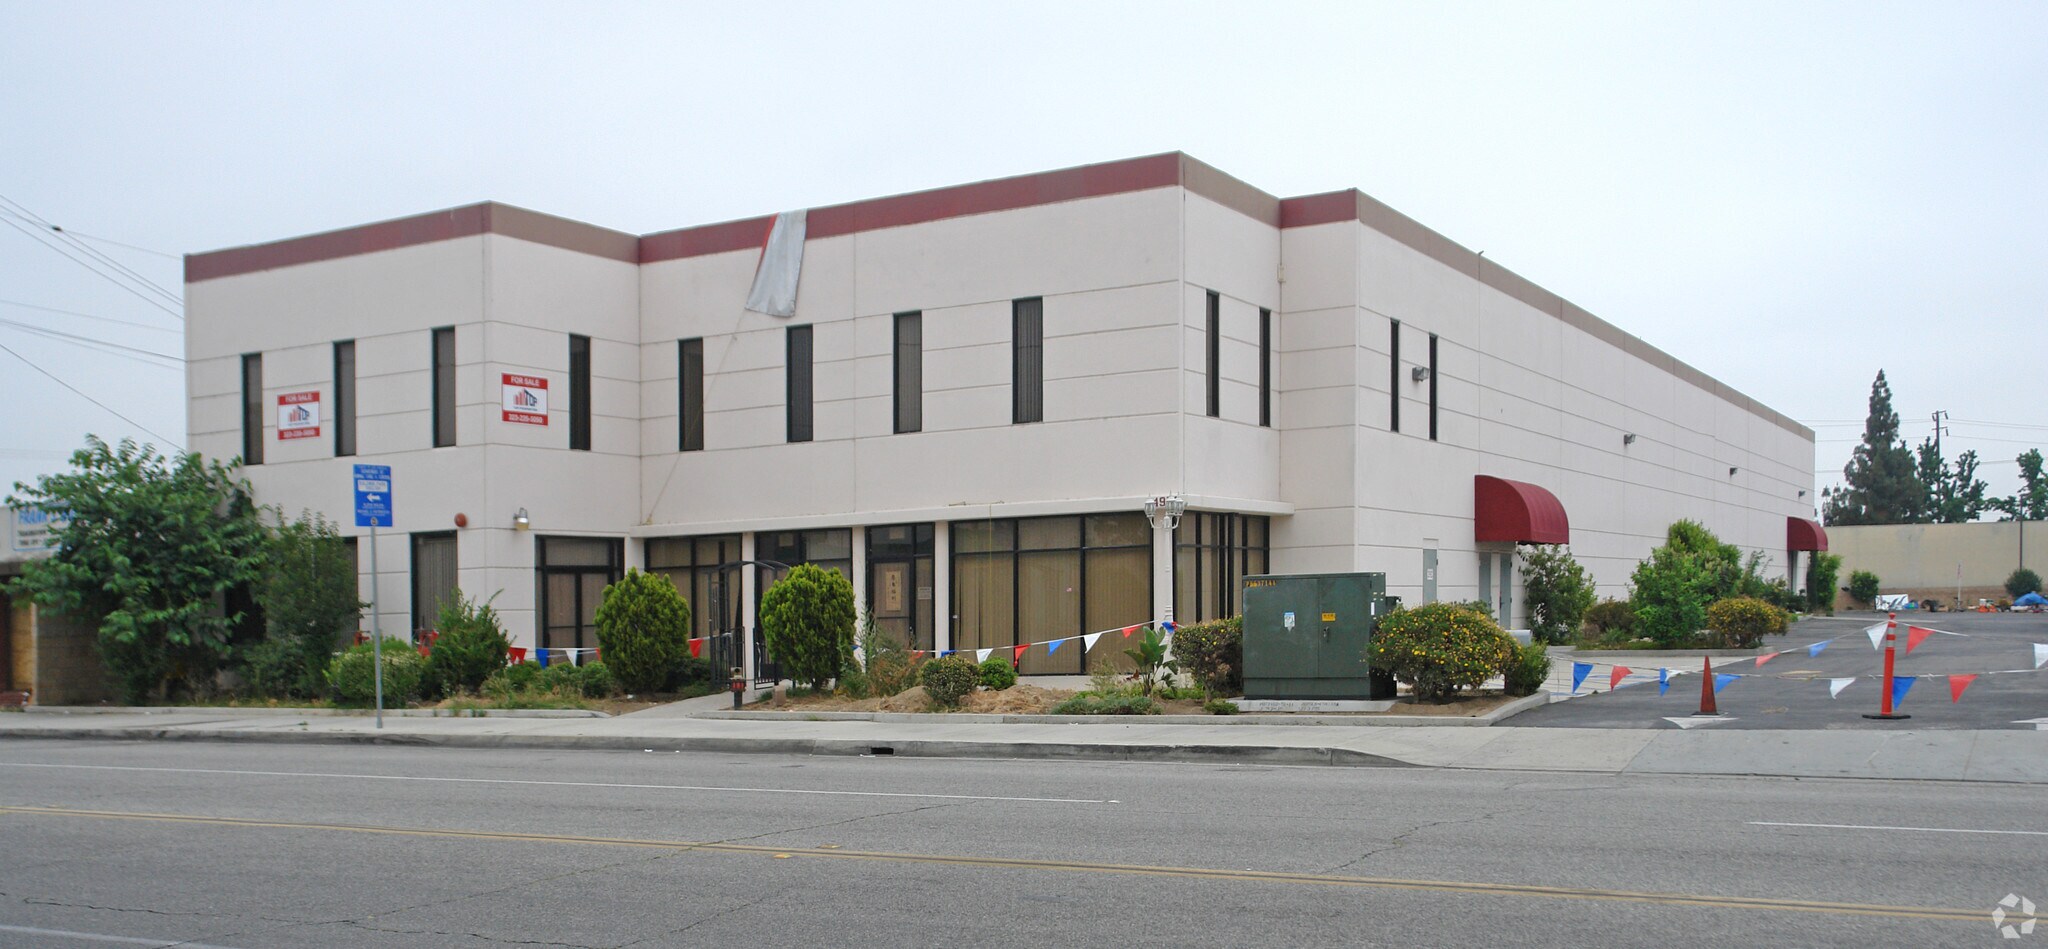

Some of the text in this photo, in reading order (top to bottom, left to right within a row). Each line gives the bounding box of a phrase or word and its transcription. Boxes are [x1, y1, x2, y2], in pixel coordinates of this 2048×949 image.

[510, 375, 540, 387] FOR SALE
[285, 391, 312, 403] FOR SALE
